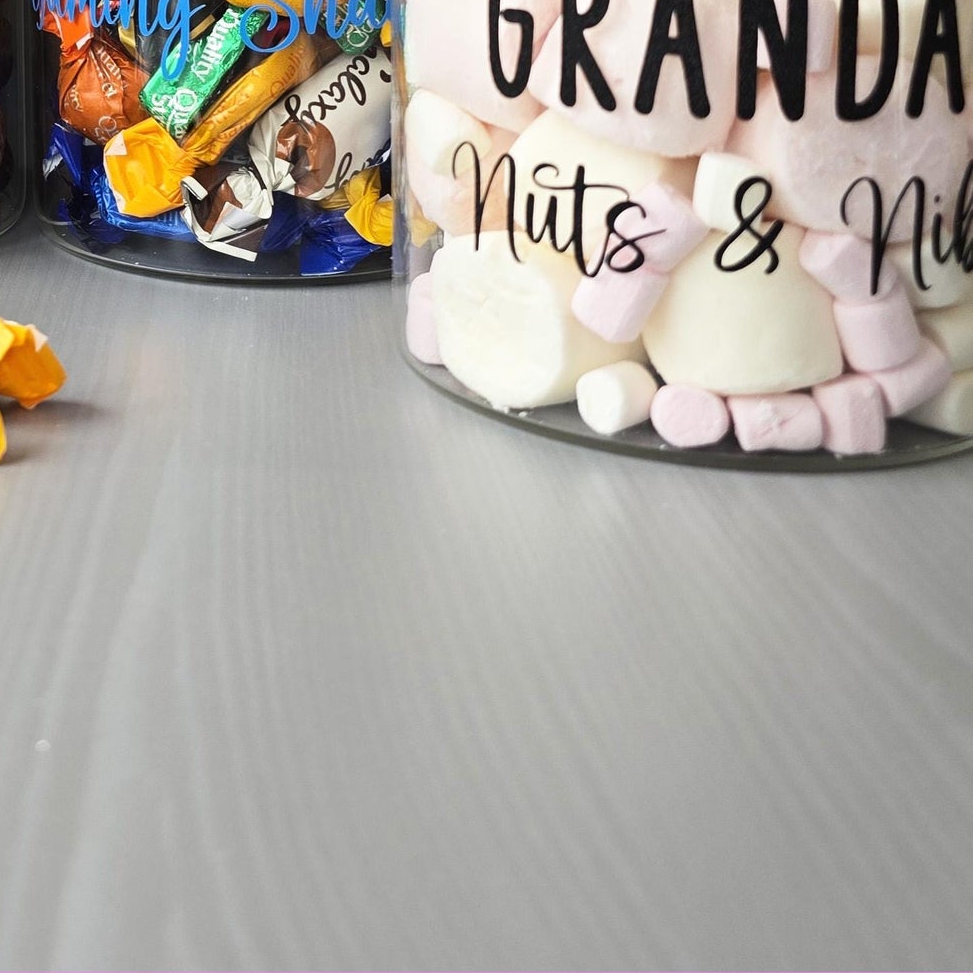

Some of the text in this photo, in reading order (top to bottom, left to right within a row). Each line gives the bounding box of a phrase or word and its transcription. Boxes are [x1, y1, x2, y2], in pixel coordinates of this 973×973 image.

[451, 140, 973, 297] Nuts & Nib
